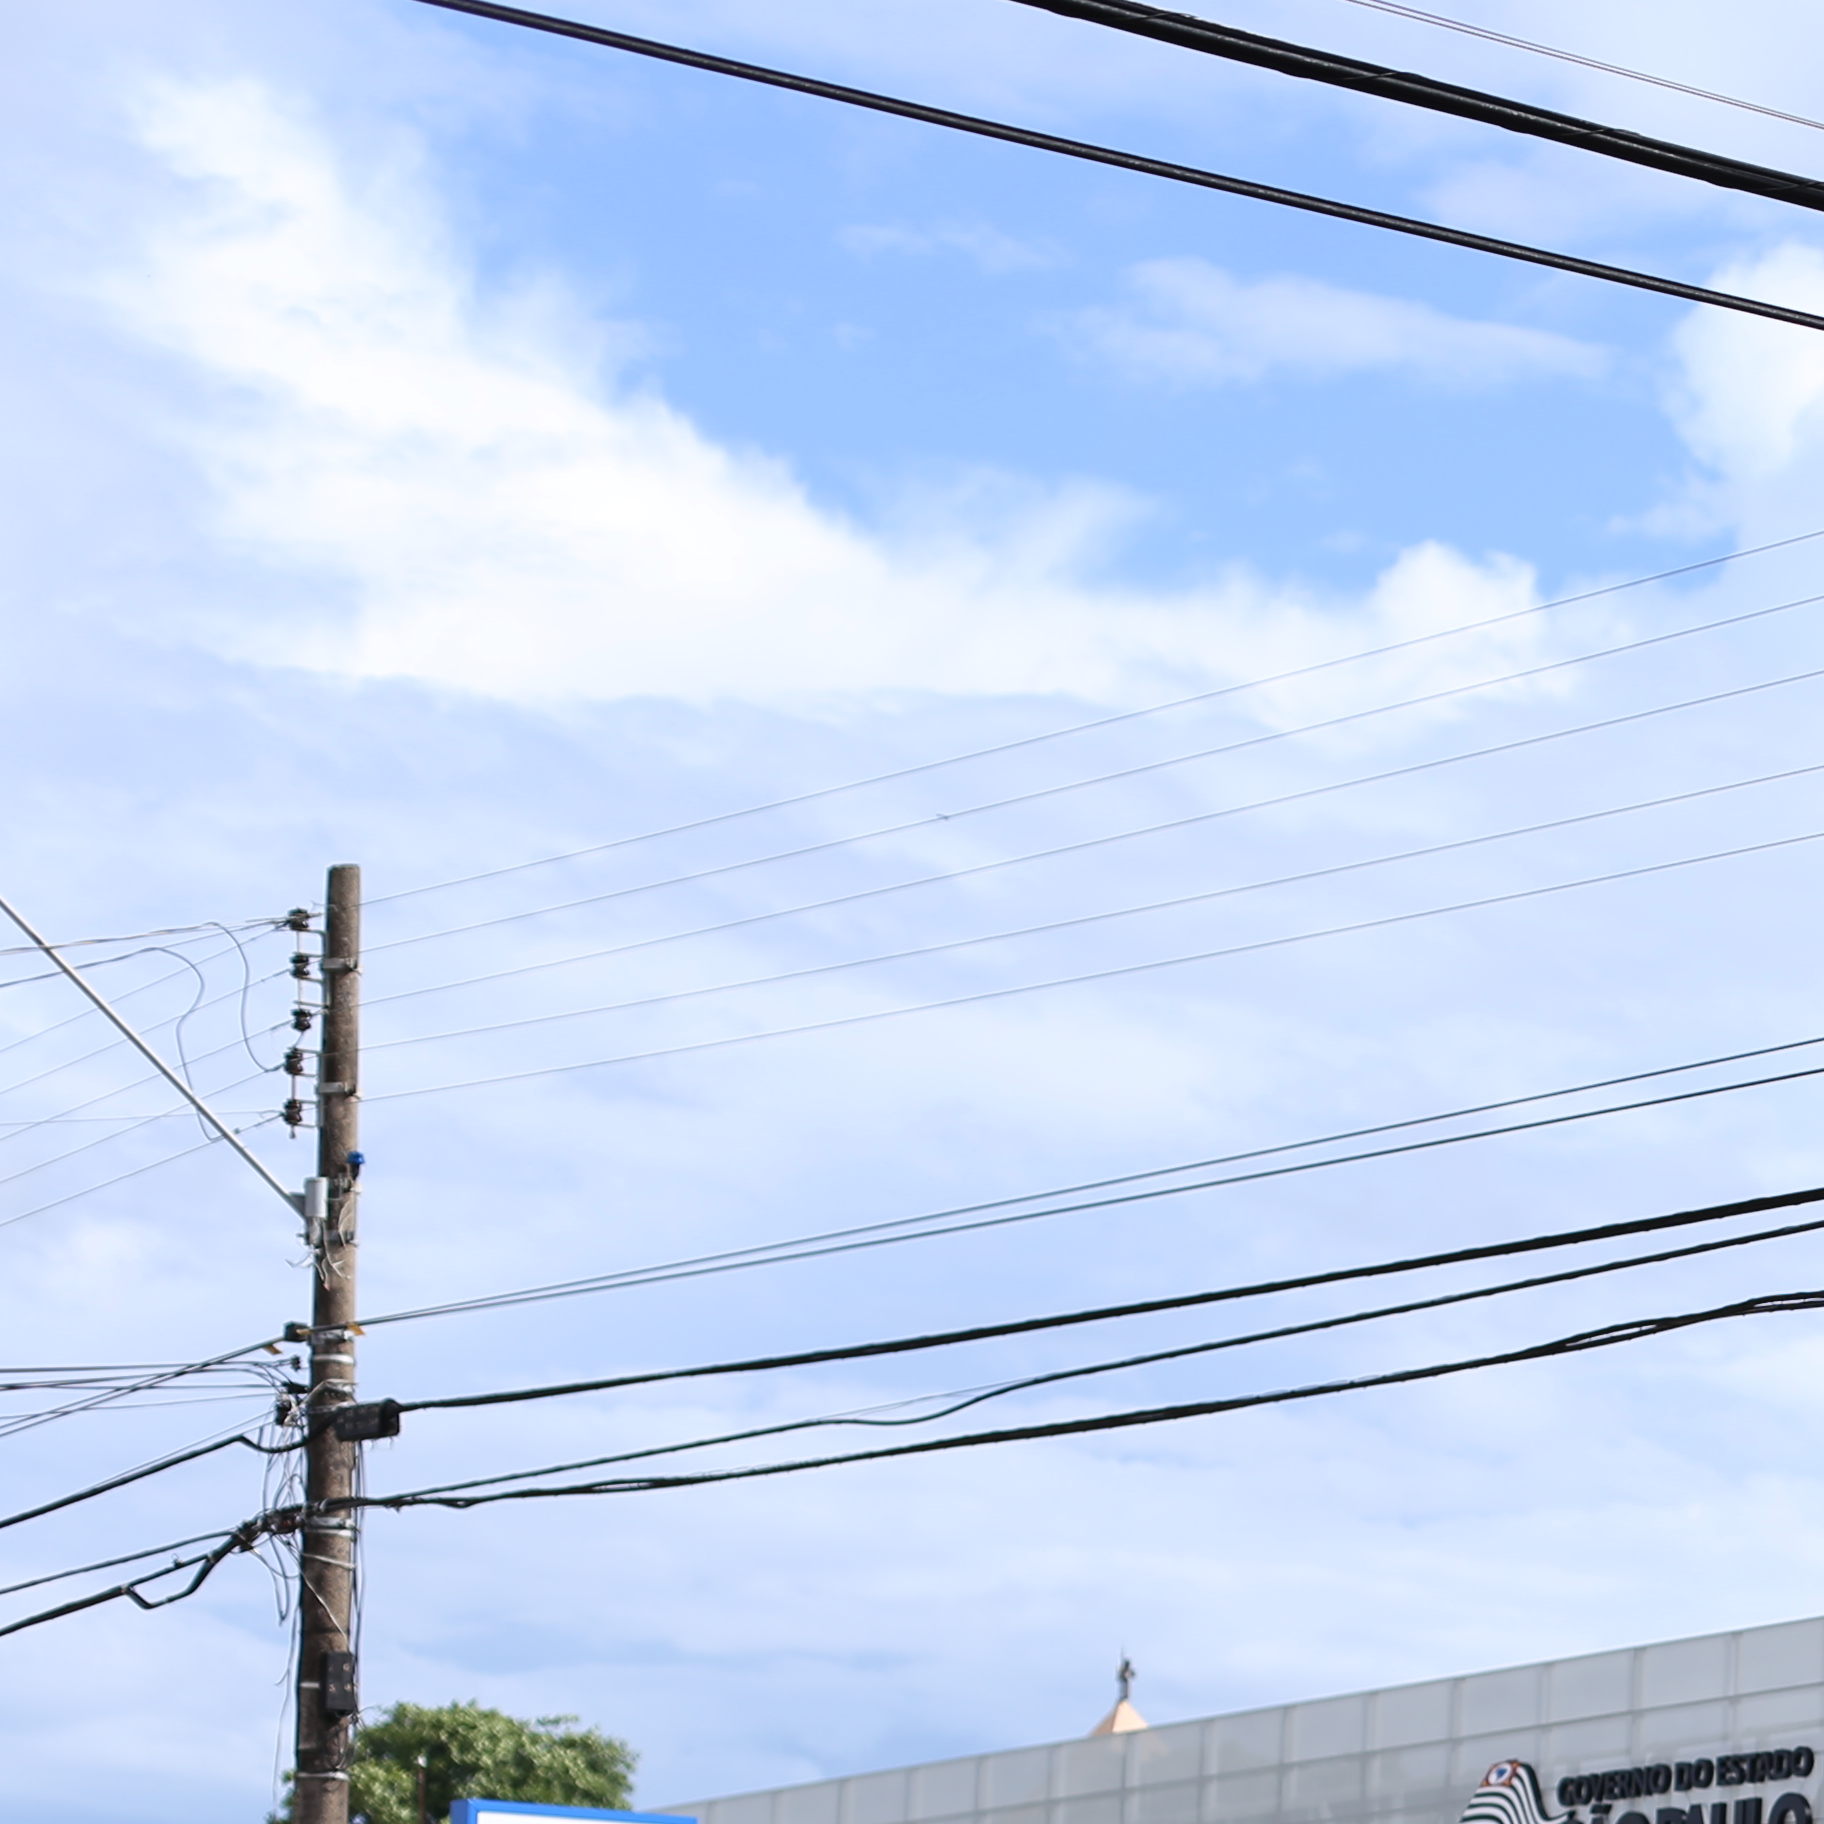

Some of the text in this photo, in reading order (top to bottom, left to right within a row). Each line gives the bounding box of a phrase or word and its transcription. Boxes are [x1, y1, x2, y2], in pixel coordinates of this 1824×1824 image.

[1557, 1746, 1815, 1807] GOVERNO DO ESTADO
